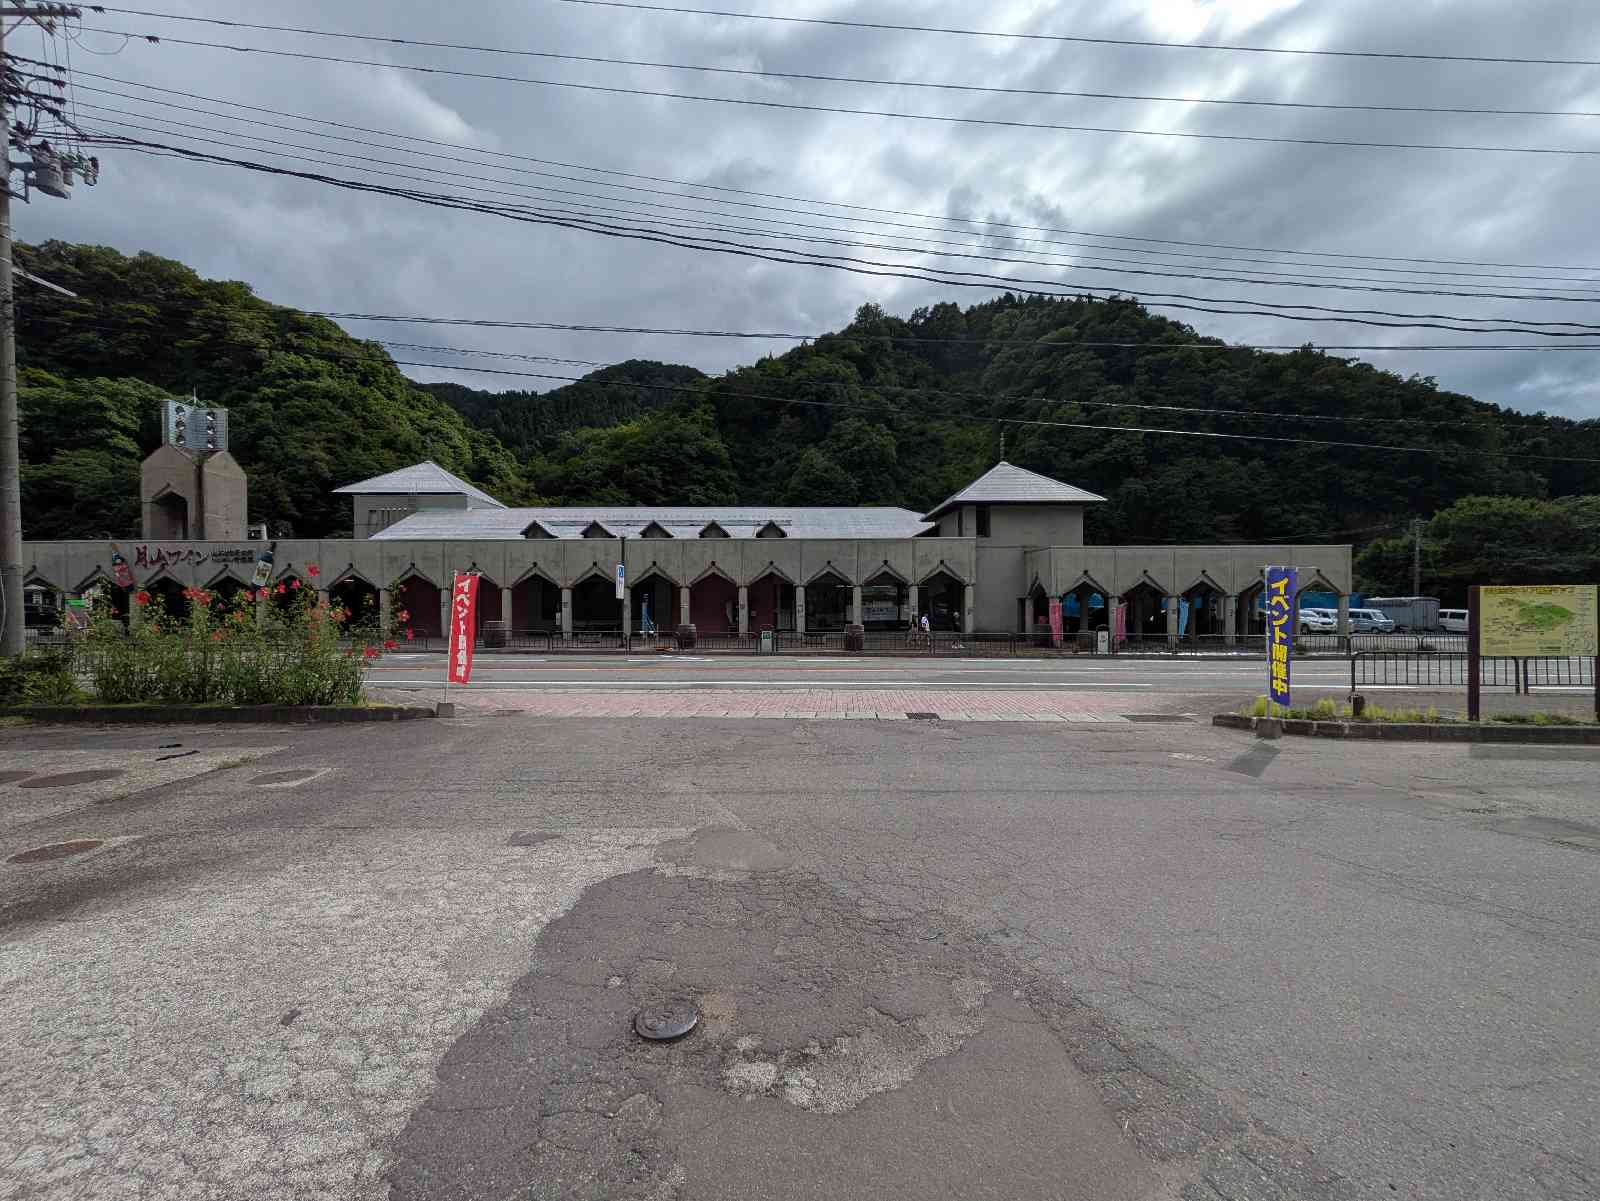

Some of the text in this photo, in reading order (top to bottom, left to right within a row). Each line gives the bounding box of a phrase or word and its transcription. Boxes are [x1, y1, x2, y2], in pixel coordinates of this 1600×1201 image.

[135, 545, 208, 567] 月山ワイン
[1271, 578, 1290, 695] イベント開催中
